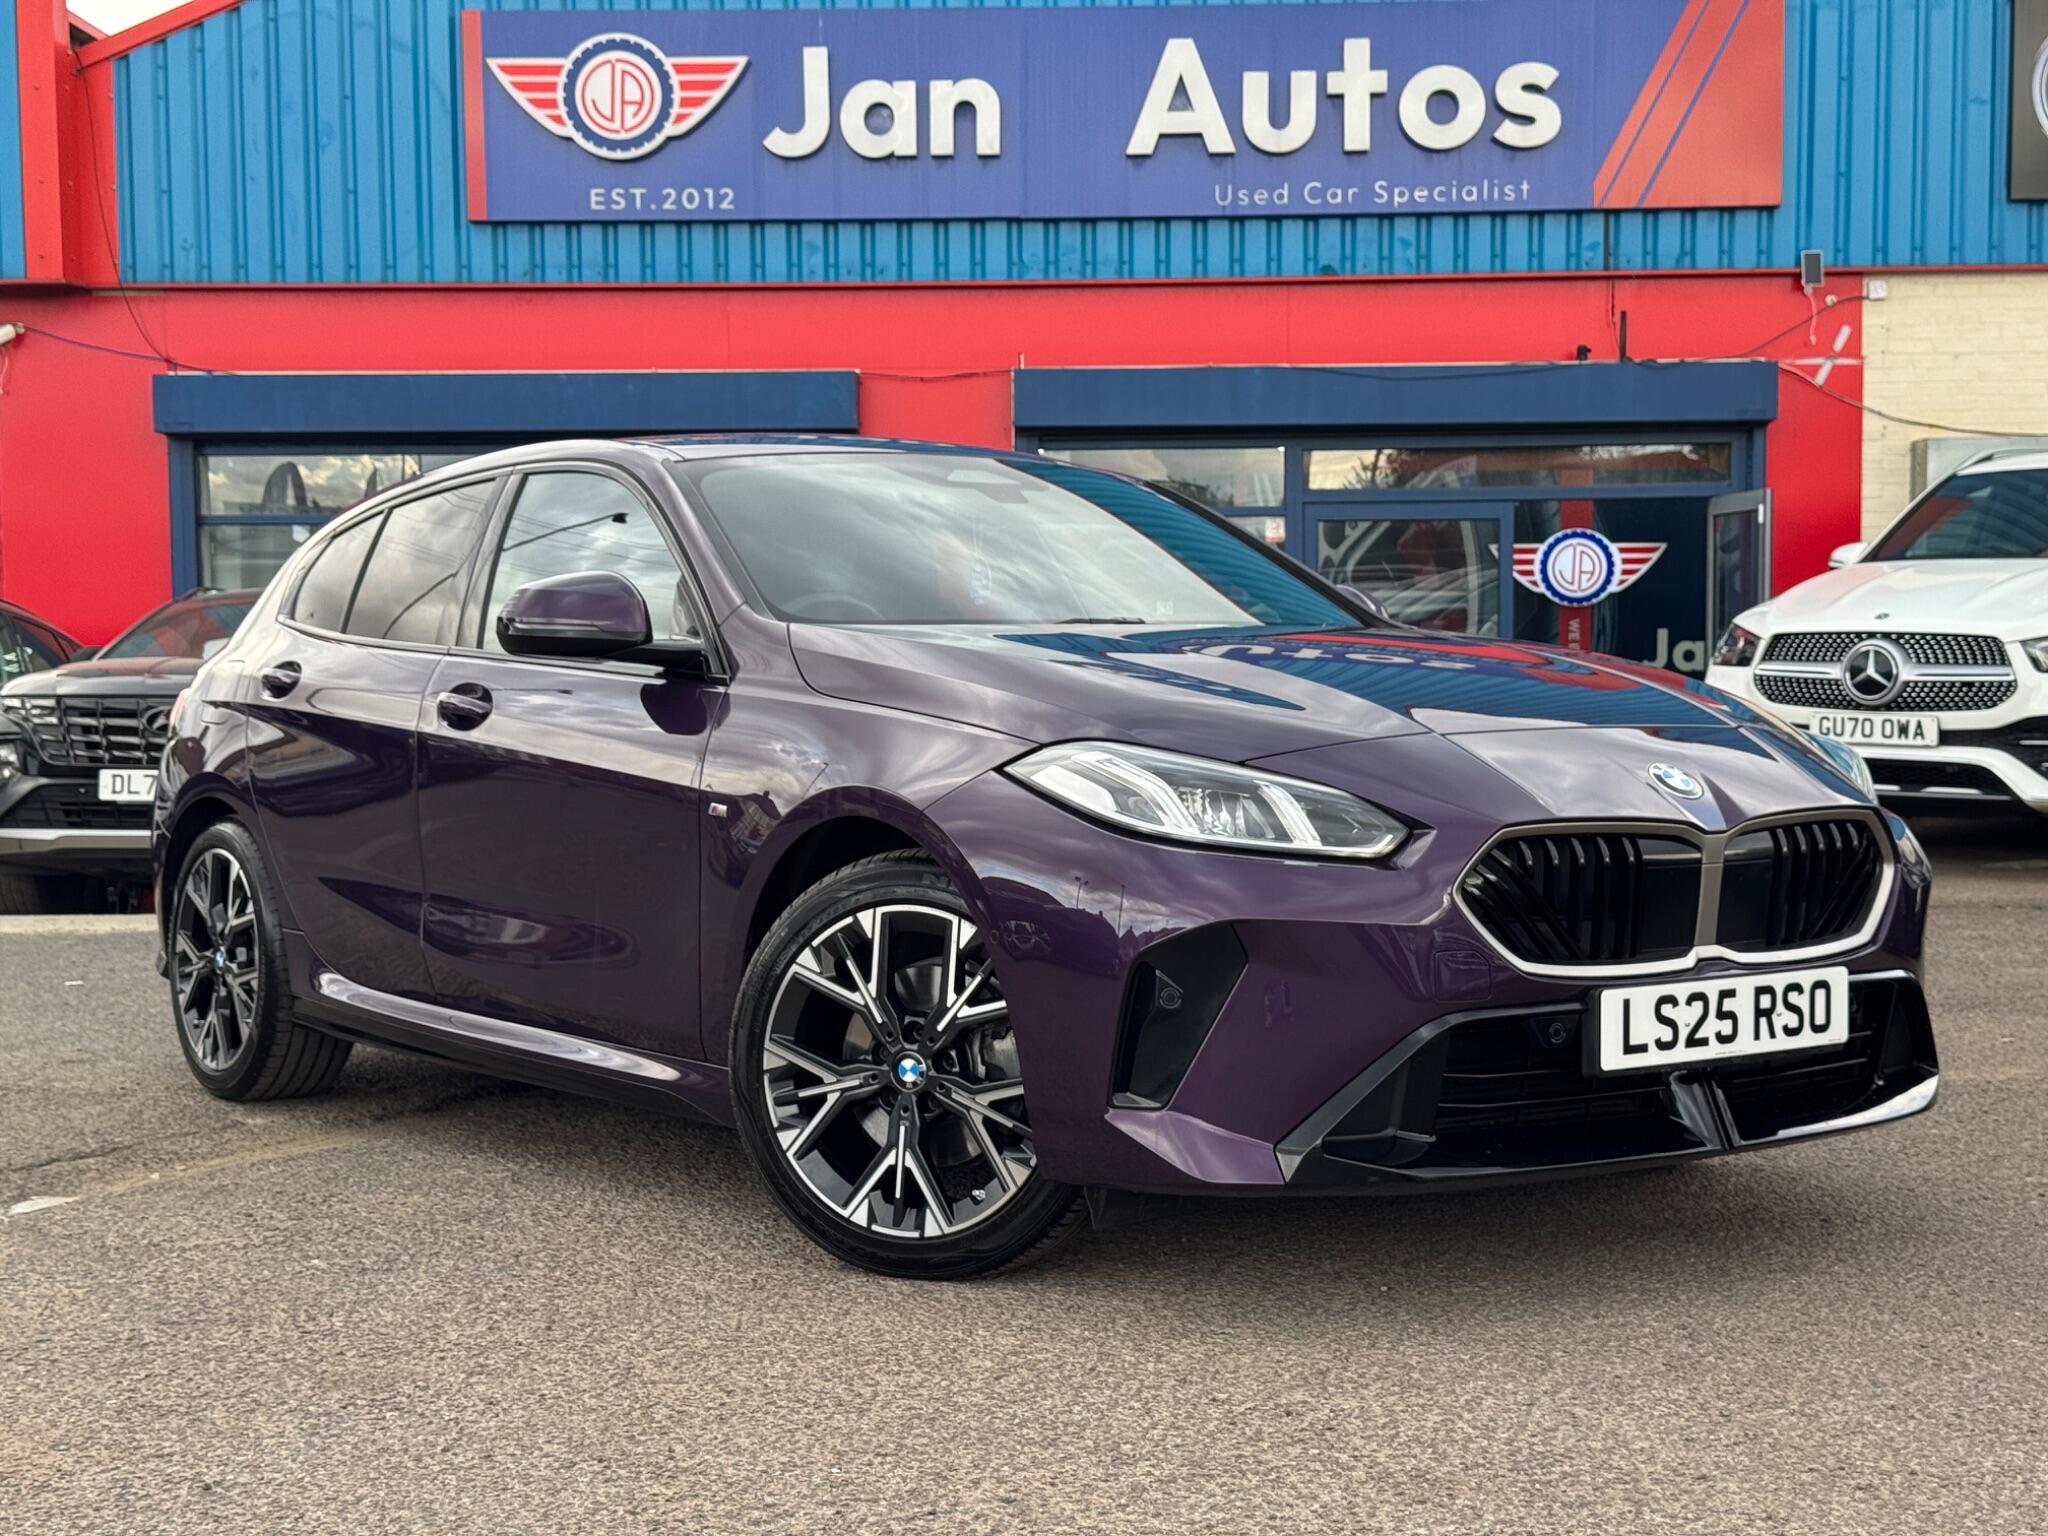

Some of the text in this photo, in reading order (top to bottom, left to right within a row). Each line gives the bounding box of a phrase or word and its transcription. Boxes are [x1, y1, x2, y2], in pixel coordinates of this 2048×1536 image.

[763, 37, 1562, 158] Jan Autos
[589, 187, 735, 211] EST.2012
[1214, 179, 1531, 208] Used Car Specialist
[1818, 716, 1926, 741] GU70 OWA
[111, 774, 157, 795] DL7
[1622, 979, 1832, 1055] LS25 RSO
